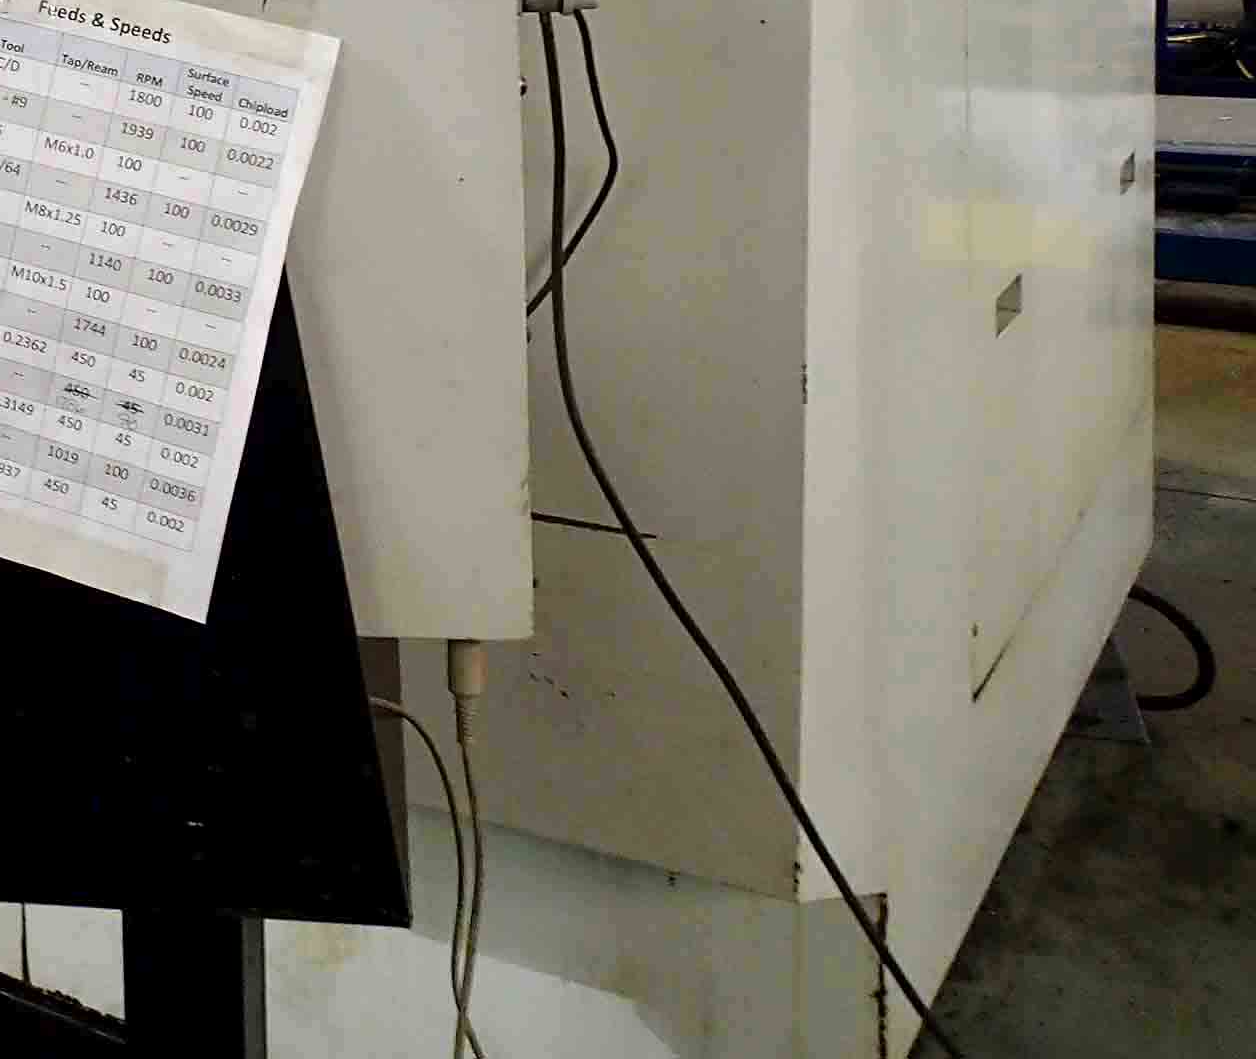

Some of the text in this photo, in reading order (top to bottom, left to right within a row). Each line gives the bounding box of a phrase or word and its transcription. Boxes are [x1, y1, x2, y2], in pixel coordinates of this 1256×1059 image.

[91, 12, 105, 29] &
[110, 17, 172, 45] Speeds
[1, 39, 25, 54] Tool
[61, 54, 119, 77] Tap/Ream
[136, 73, 164, 89] RPM
[187, 68, 230, 88] Surface
[128, 90, 163, 108] 1800
[188, 104, 214, 121] 100
[239, 116, 278, 137] 0.002
[186, 85, 289, 121] Speed Chipload
[44, 137, 95, 160] M6x1.0
[117, 155, 143, 172] 100
[121, 122, 155, 140] 1939
[181, 137, 207, 153] 100
[227, 148, 275, 171] 0.0022
[24, 200, 82, 226] M8x1.25
[100, 221, 126, 238] 100
[104, 188, 137, 206] 1436
[164, 202, 190, 219] 100
[210, 214, 259, 237] 0.0029
[11, 266, 68, 291] M10x1.5
[85, 287, 111, 304] 100
[89, 253, 122, 272] 1140
[148, 268, 174, 286] 100
[195, 280, 242, 303] 0.0033
[3, 331, 48, 354] 0.2362
[71, 351, 96, 368] 450
[128, 368, 145, 382] 45
[175, 381, 215, 403] 0.002
[73, 317, 106, 337] 1744
[132, 335, 158, 351] 100
[178, 347, 226, 370] 0.0024
[57, 415, 83, 431] 450
[114, 432, 132, 446] 45
[160, 447, 200, 469] 0.002
[163, 413, 209, 437] 0.0031
[47, 445, 80, 465] 1019
[104, 463, 129, 481] 100
[149, 477, 196, 502] 0.0036
[43, 478, 70, 495] 450
[101, 496, 119, 511] 45
[145, 510, 185, 533] 0.002
